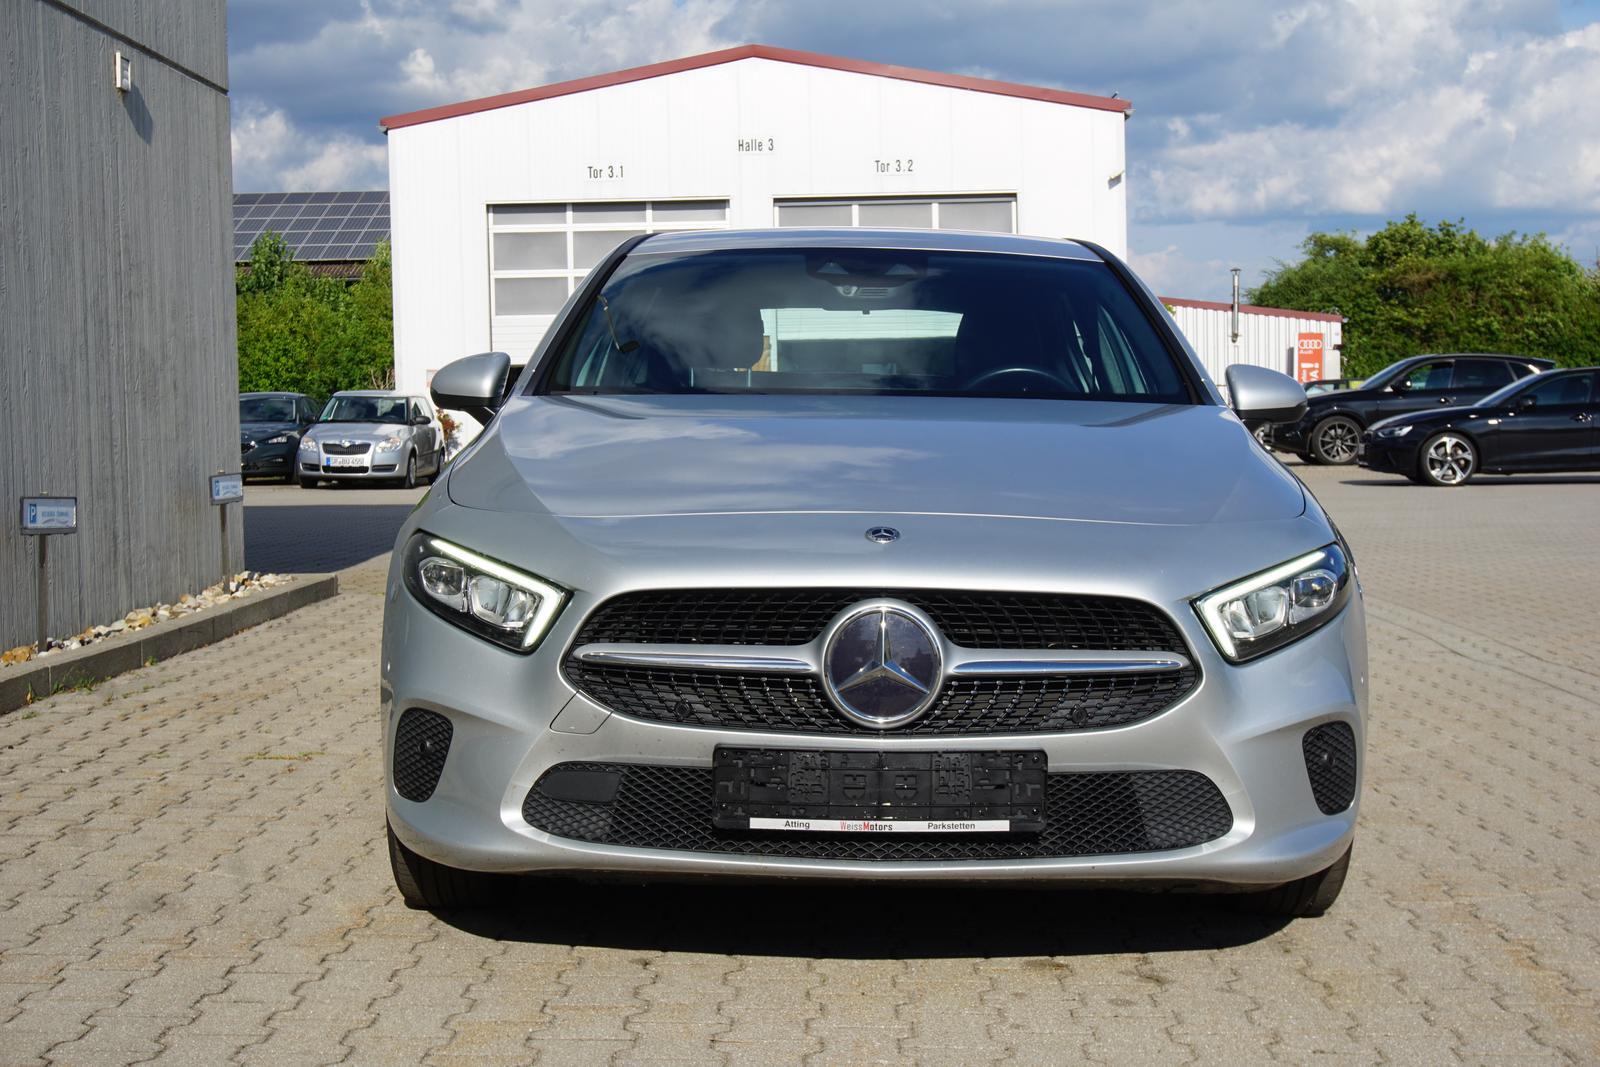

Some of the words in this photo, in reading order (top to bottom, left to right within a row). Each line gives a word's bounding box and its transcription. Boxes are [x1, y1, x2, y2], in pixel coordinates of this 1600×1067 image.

[738, 139, 763, 152] Halle
[768, 138, 774, 151] 3
[587, 166, 603, 179] Tor
[608, 165, 624, 178] 3.1
[875, 160, 890, 173] Tor
[895, 159, 913, 172] 3.2
[784, 820, 810, 829] Atting
[840, 822, 893, 831] WeissMotors
